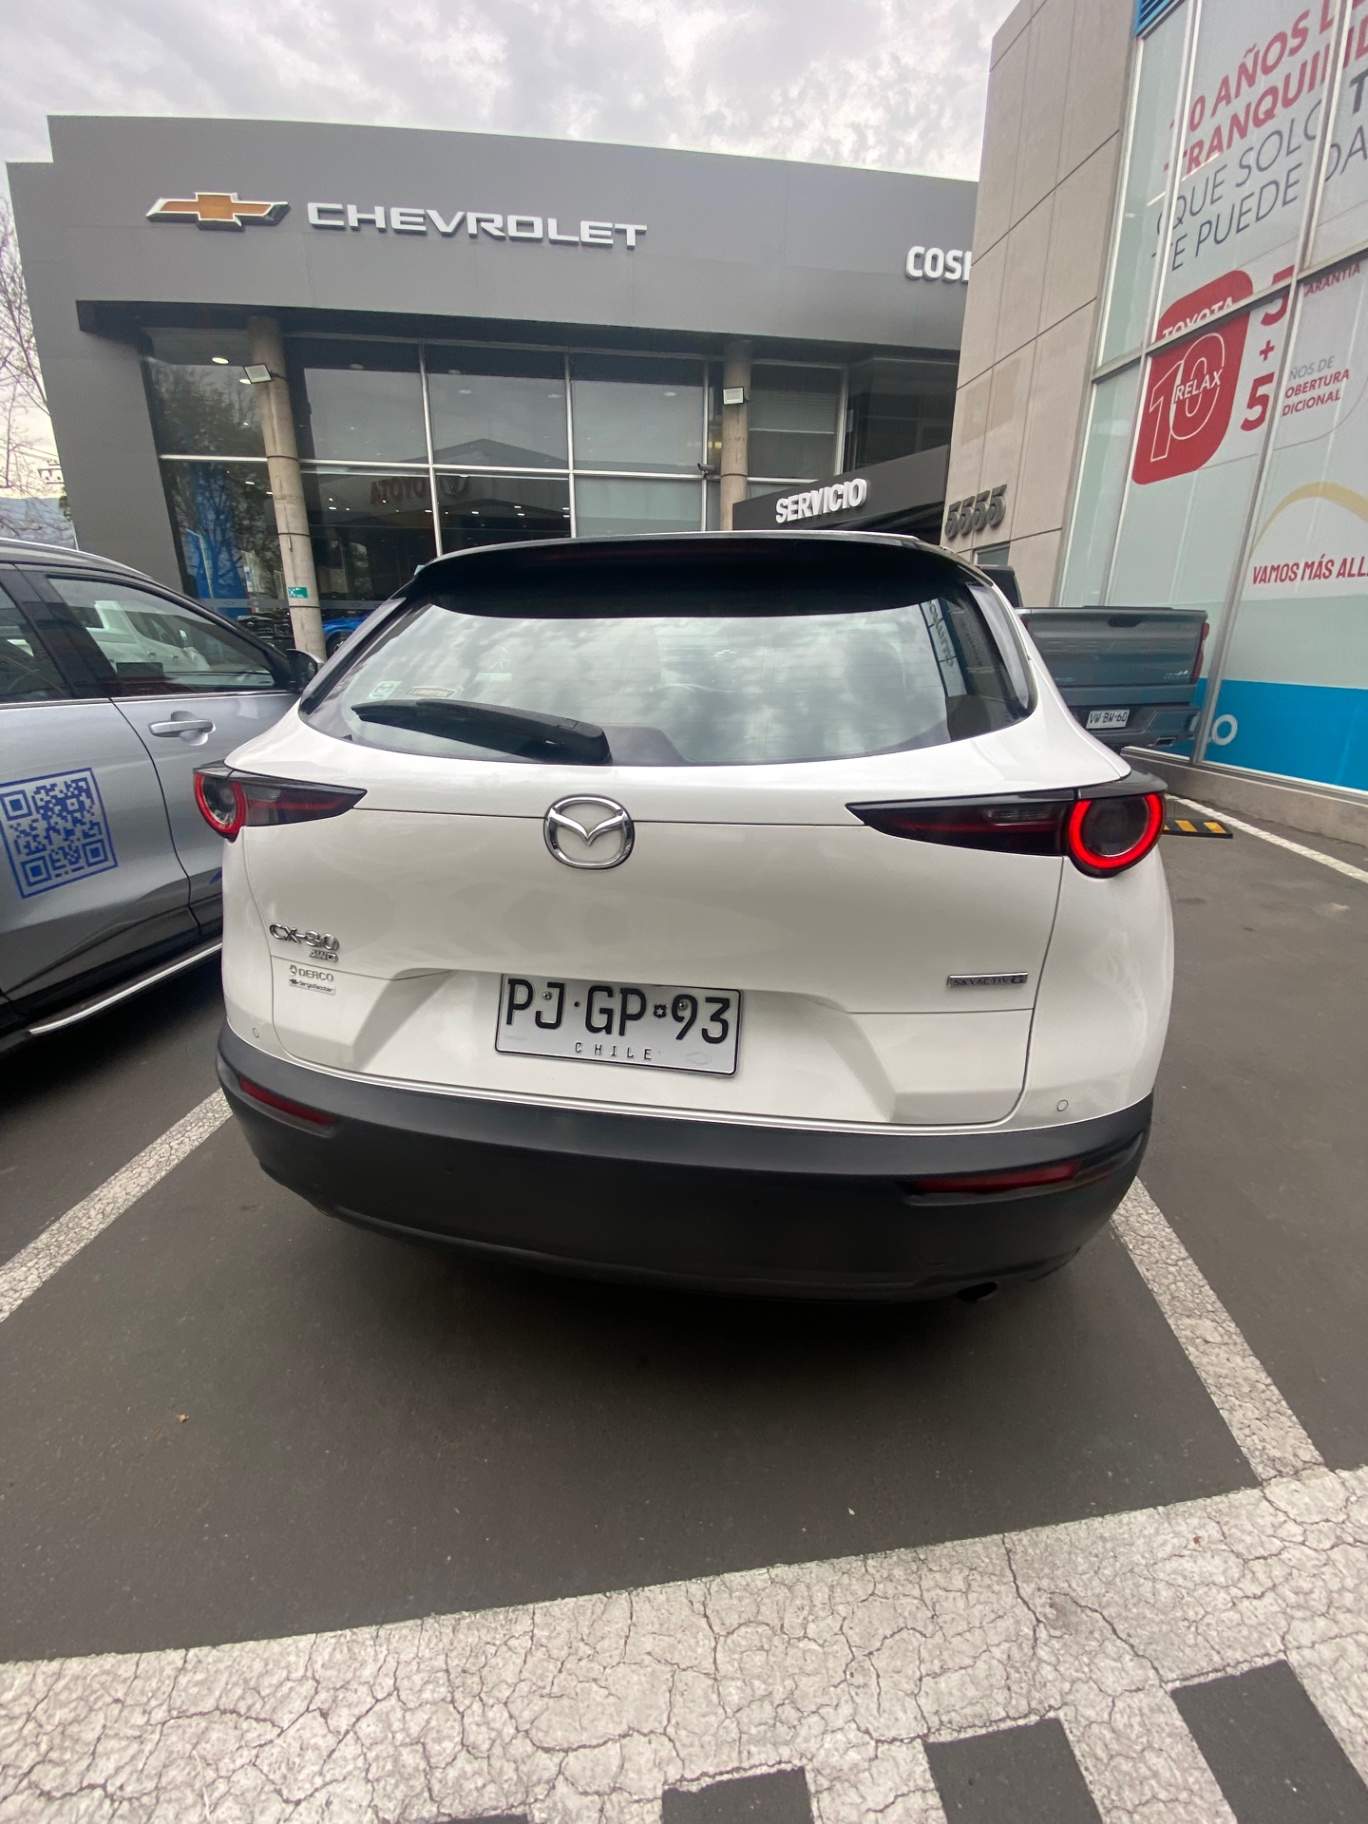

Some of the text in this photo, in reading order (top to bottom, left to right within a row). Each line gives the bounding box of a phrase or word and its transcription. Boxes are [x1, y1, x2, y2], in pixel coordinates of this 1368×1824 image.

[1211, 10, 1311, 118] AÑOS
[307, 202, 648, 248] CHEVROLET
[1195, 162, 1303, 257] PUEDE
[1175, 370, 1223, 402] RELAX
[1284, 368, 1350, 399] OBERTURA
[1240, 372, 1275, 432] 5
[1281, 389, 1341, 417] DICIONAL
[776, 478, 867, 524] SERVICIO
[1253, 553, 1368, 584] VAMOS MÁS ALL
[269, 923, 340, 951] CX-30
[298, 967, 334, 982] DERCO
[575, 1042, 652, 1060] CHILE
